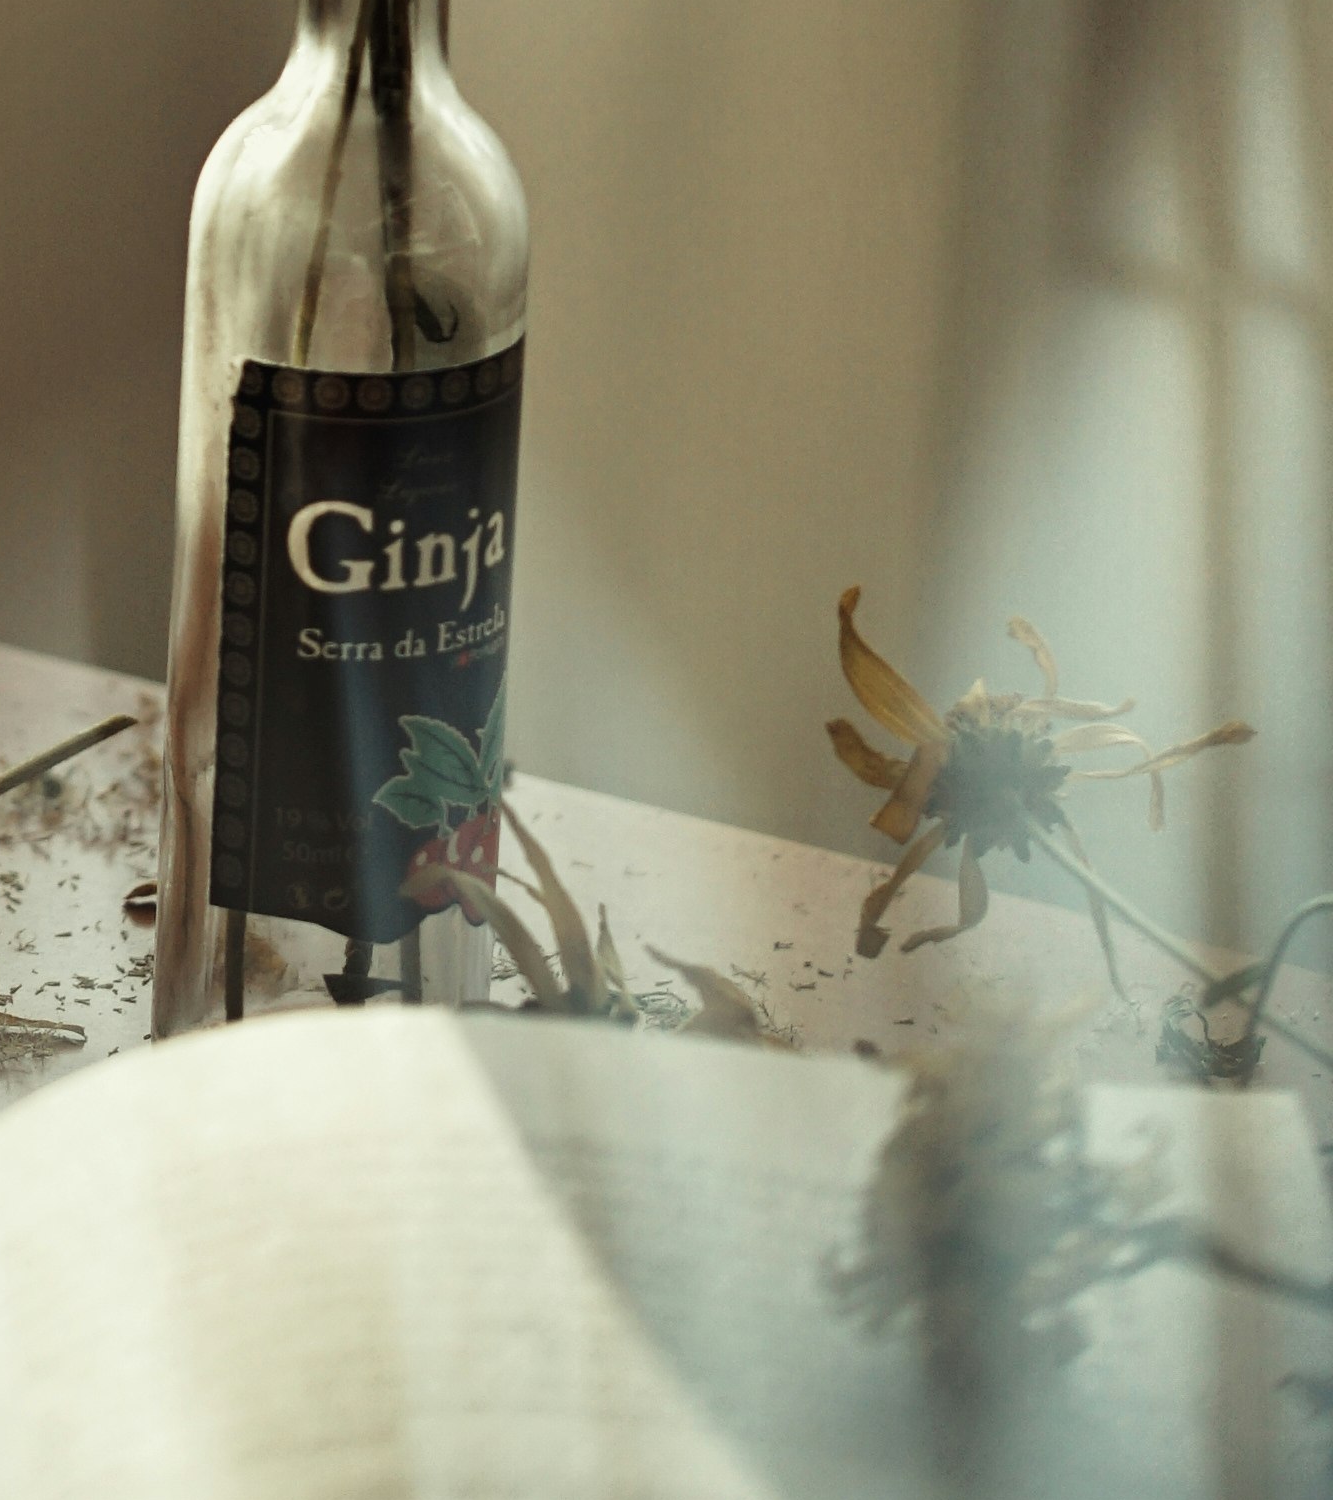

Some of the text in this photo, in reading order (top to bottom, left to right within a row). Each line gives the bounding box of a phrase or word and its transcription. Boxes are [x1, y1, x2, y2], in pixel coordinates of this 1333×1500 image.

[286, 500, 506, 612] Ginja
[296, 627, 385, 661] Serra
[393, 629, 426, 658] da
[436, 603, 506, 653] Estrela
